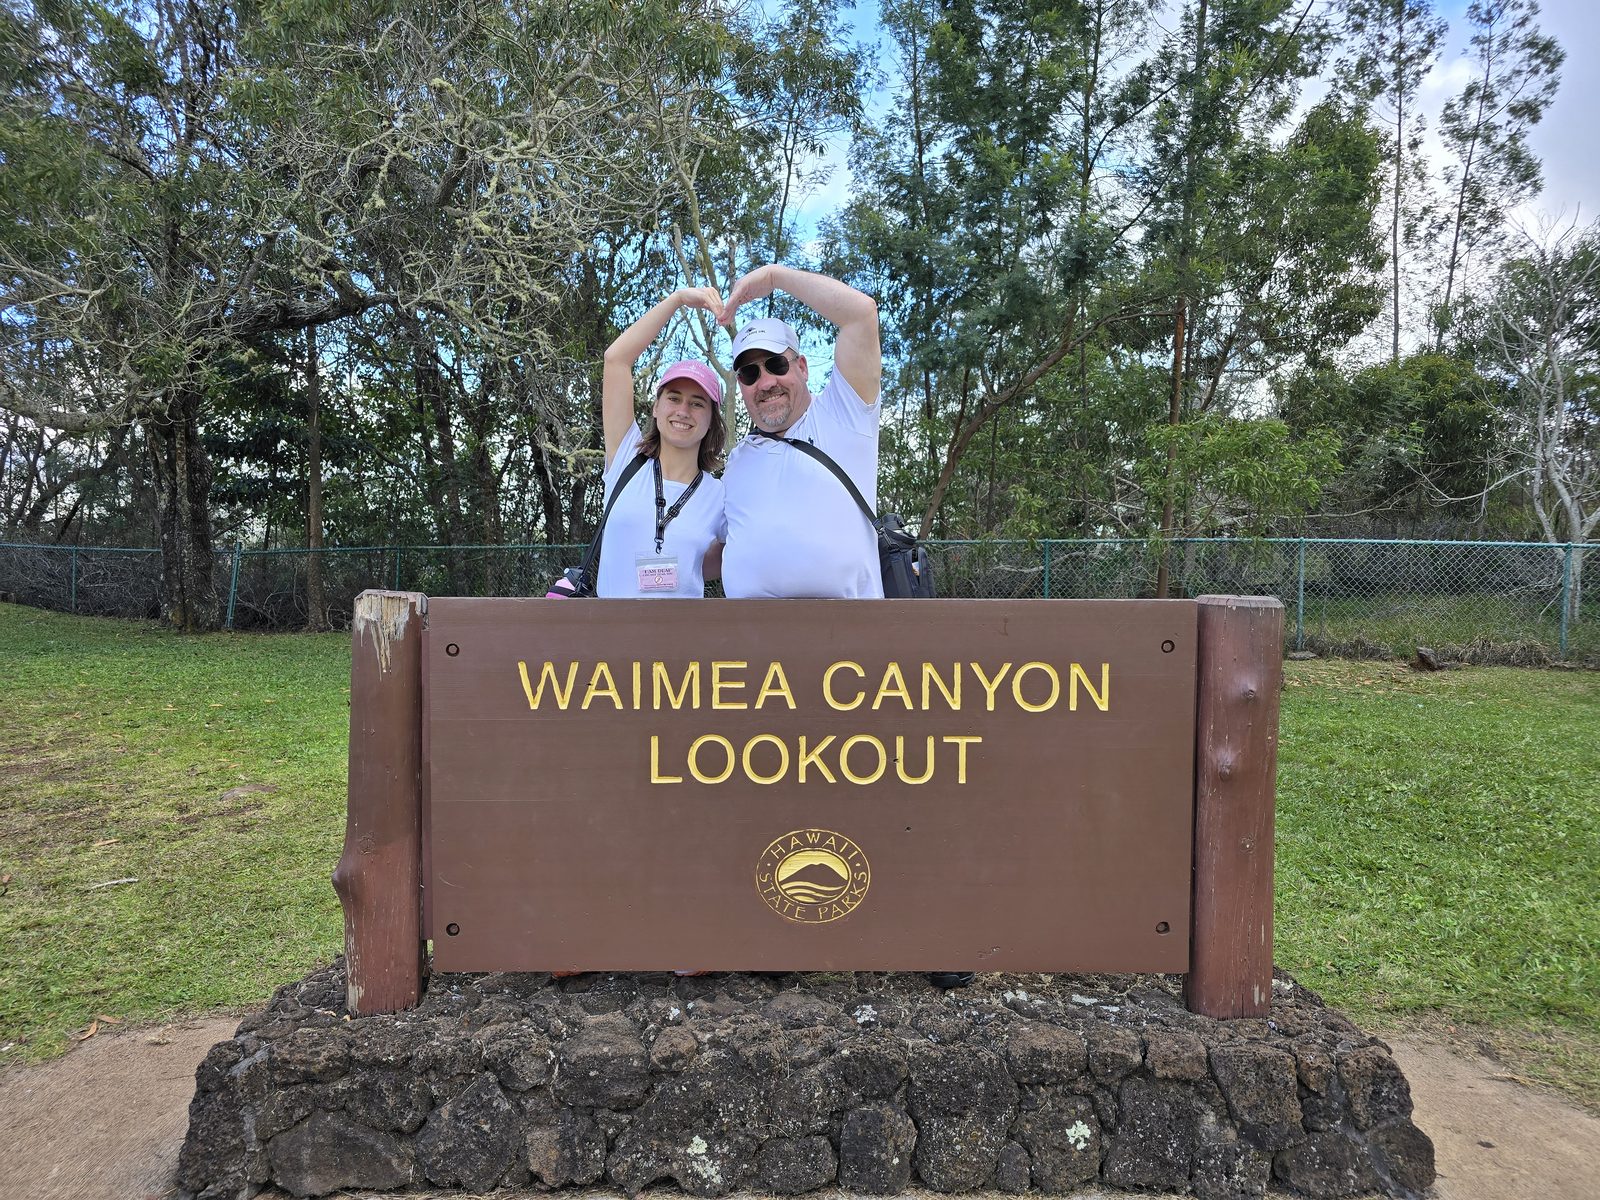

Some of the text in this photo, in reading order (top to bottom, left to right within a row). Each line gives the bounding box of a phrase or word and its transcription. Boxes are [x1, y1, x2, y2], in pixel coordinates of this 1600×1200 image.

[518, 661, 1110, 712] WAIMEA CANYON
[651, 734, 983, 786] LOOKOUT
[770, 832, 858, 860] HAWAII
[759, 871, 867, 920] STATE PARKS
